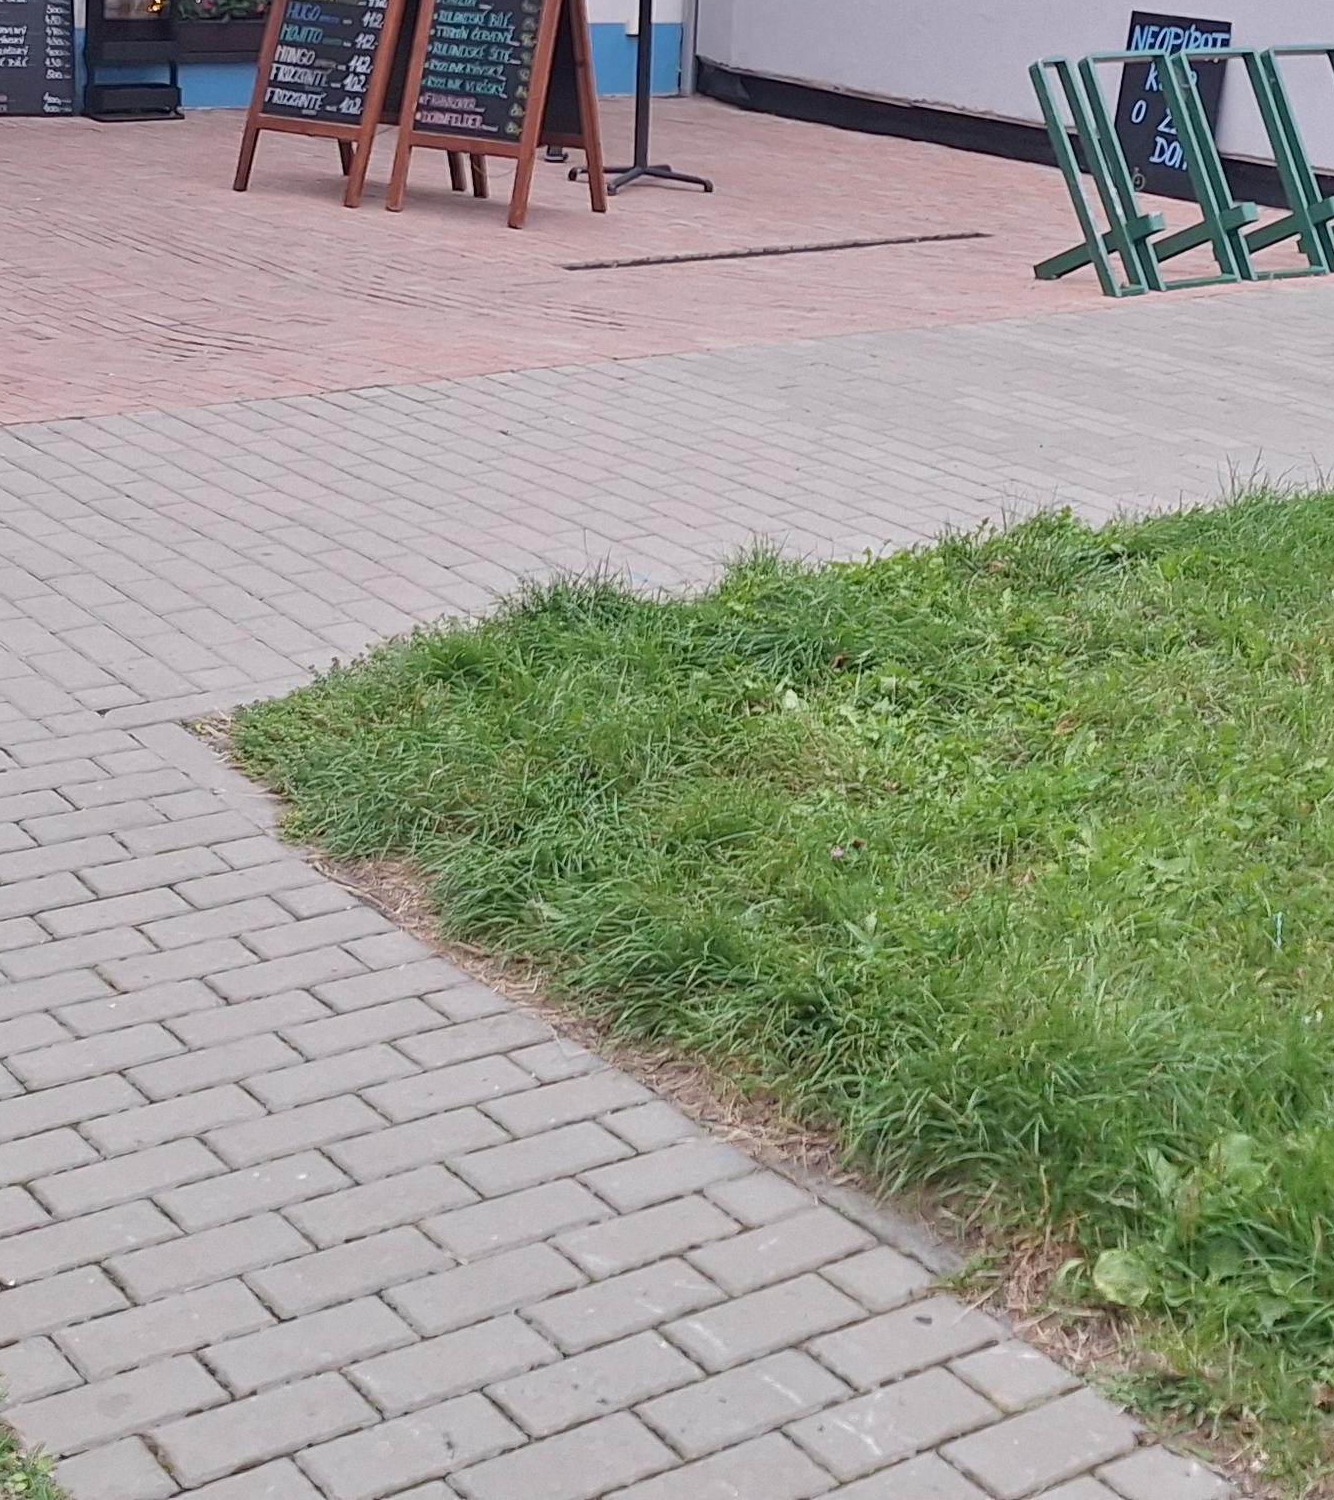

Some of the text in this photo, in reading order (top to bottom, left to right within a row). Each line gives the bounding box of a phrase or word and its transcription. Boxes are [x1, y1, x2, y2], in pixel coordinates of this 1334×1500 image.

[287, 1, 322, 21] HUGO
[280, 23, 323, 44] MOJITO
[274, 44, 316, 66] MANGO
